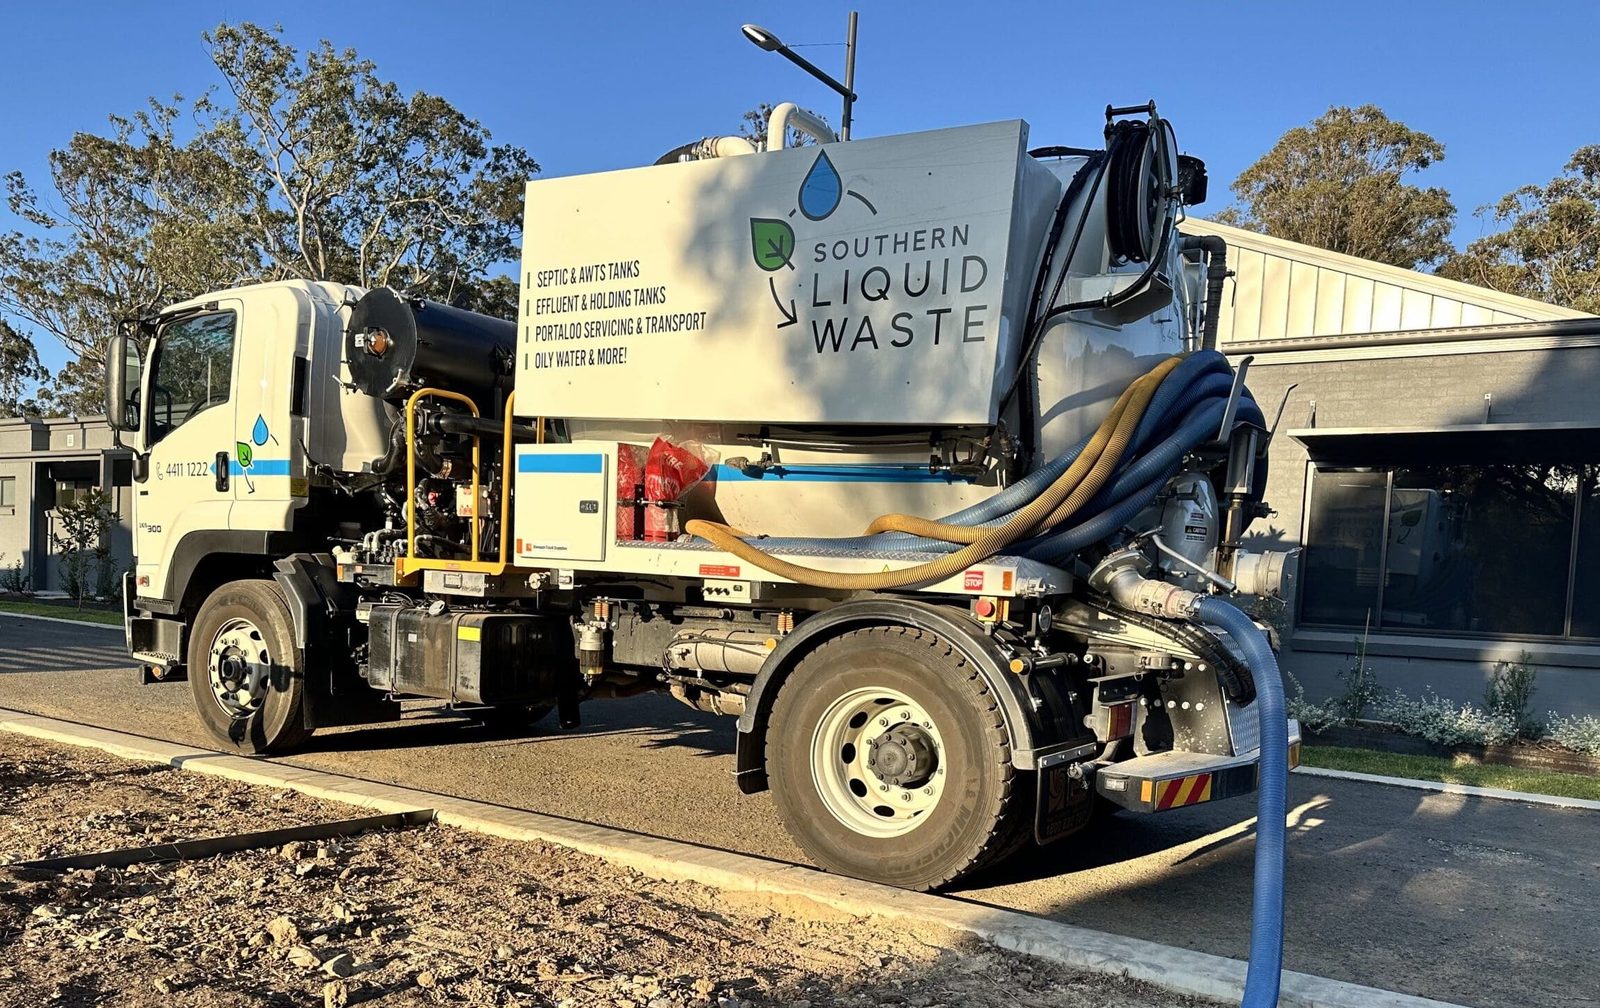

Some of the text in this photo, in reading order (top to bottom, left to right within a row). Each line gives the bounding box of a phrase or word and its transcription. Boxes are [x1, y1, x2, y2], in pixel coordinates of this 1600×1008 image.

[814, 224, 969, 263] SOUTHERN
[537, 260, 640, 288] SEPTIC & AWTS TANKS
[812, 255, 988, 307] LIQUID
[536, 286, 666, 315] EFFLUENT & HOLDING TANKS
[535, 312, 707, 342] PORTALOO SERVICING & TRANSPORT
[812, 305, 988, 354] WASTE
[535, 347, 628, 369] OILY WATER & MORE!
[166, 462, 208, 477] 4411 1222
[965, 579, 982, 588] STOP
